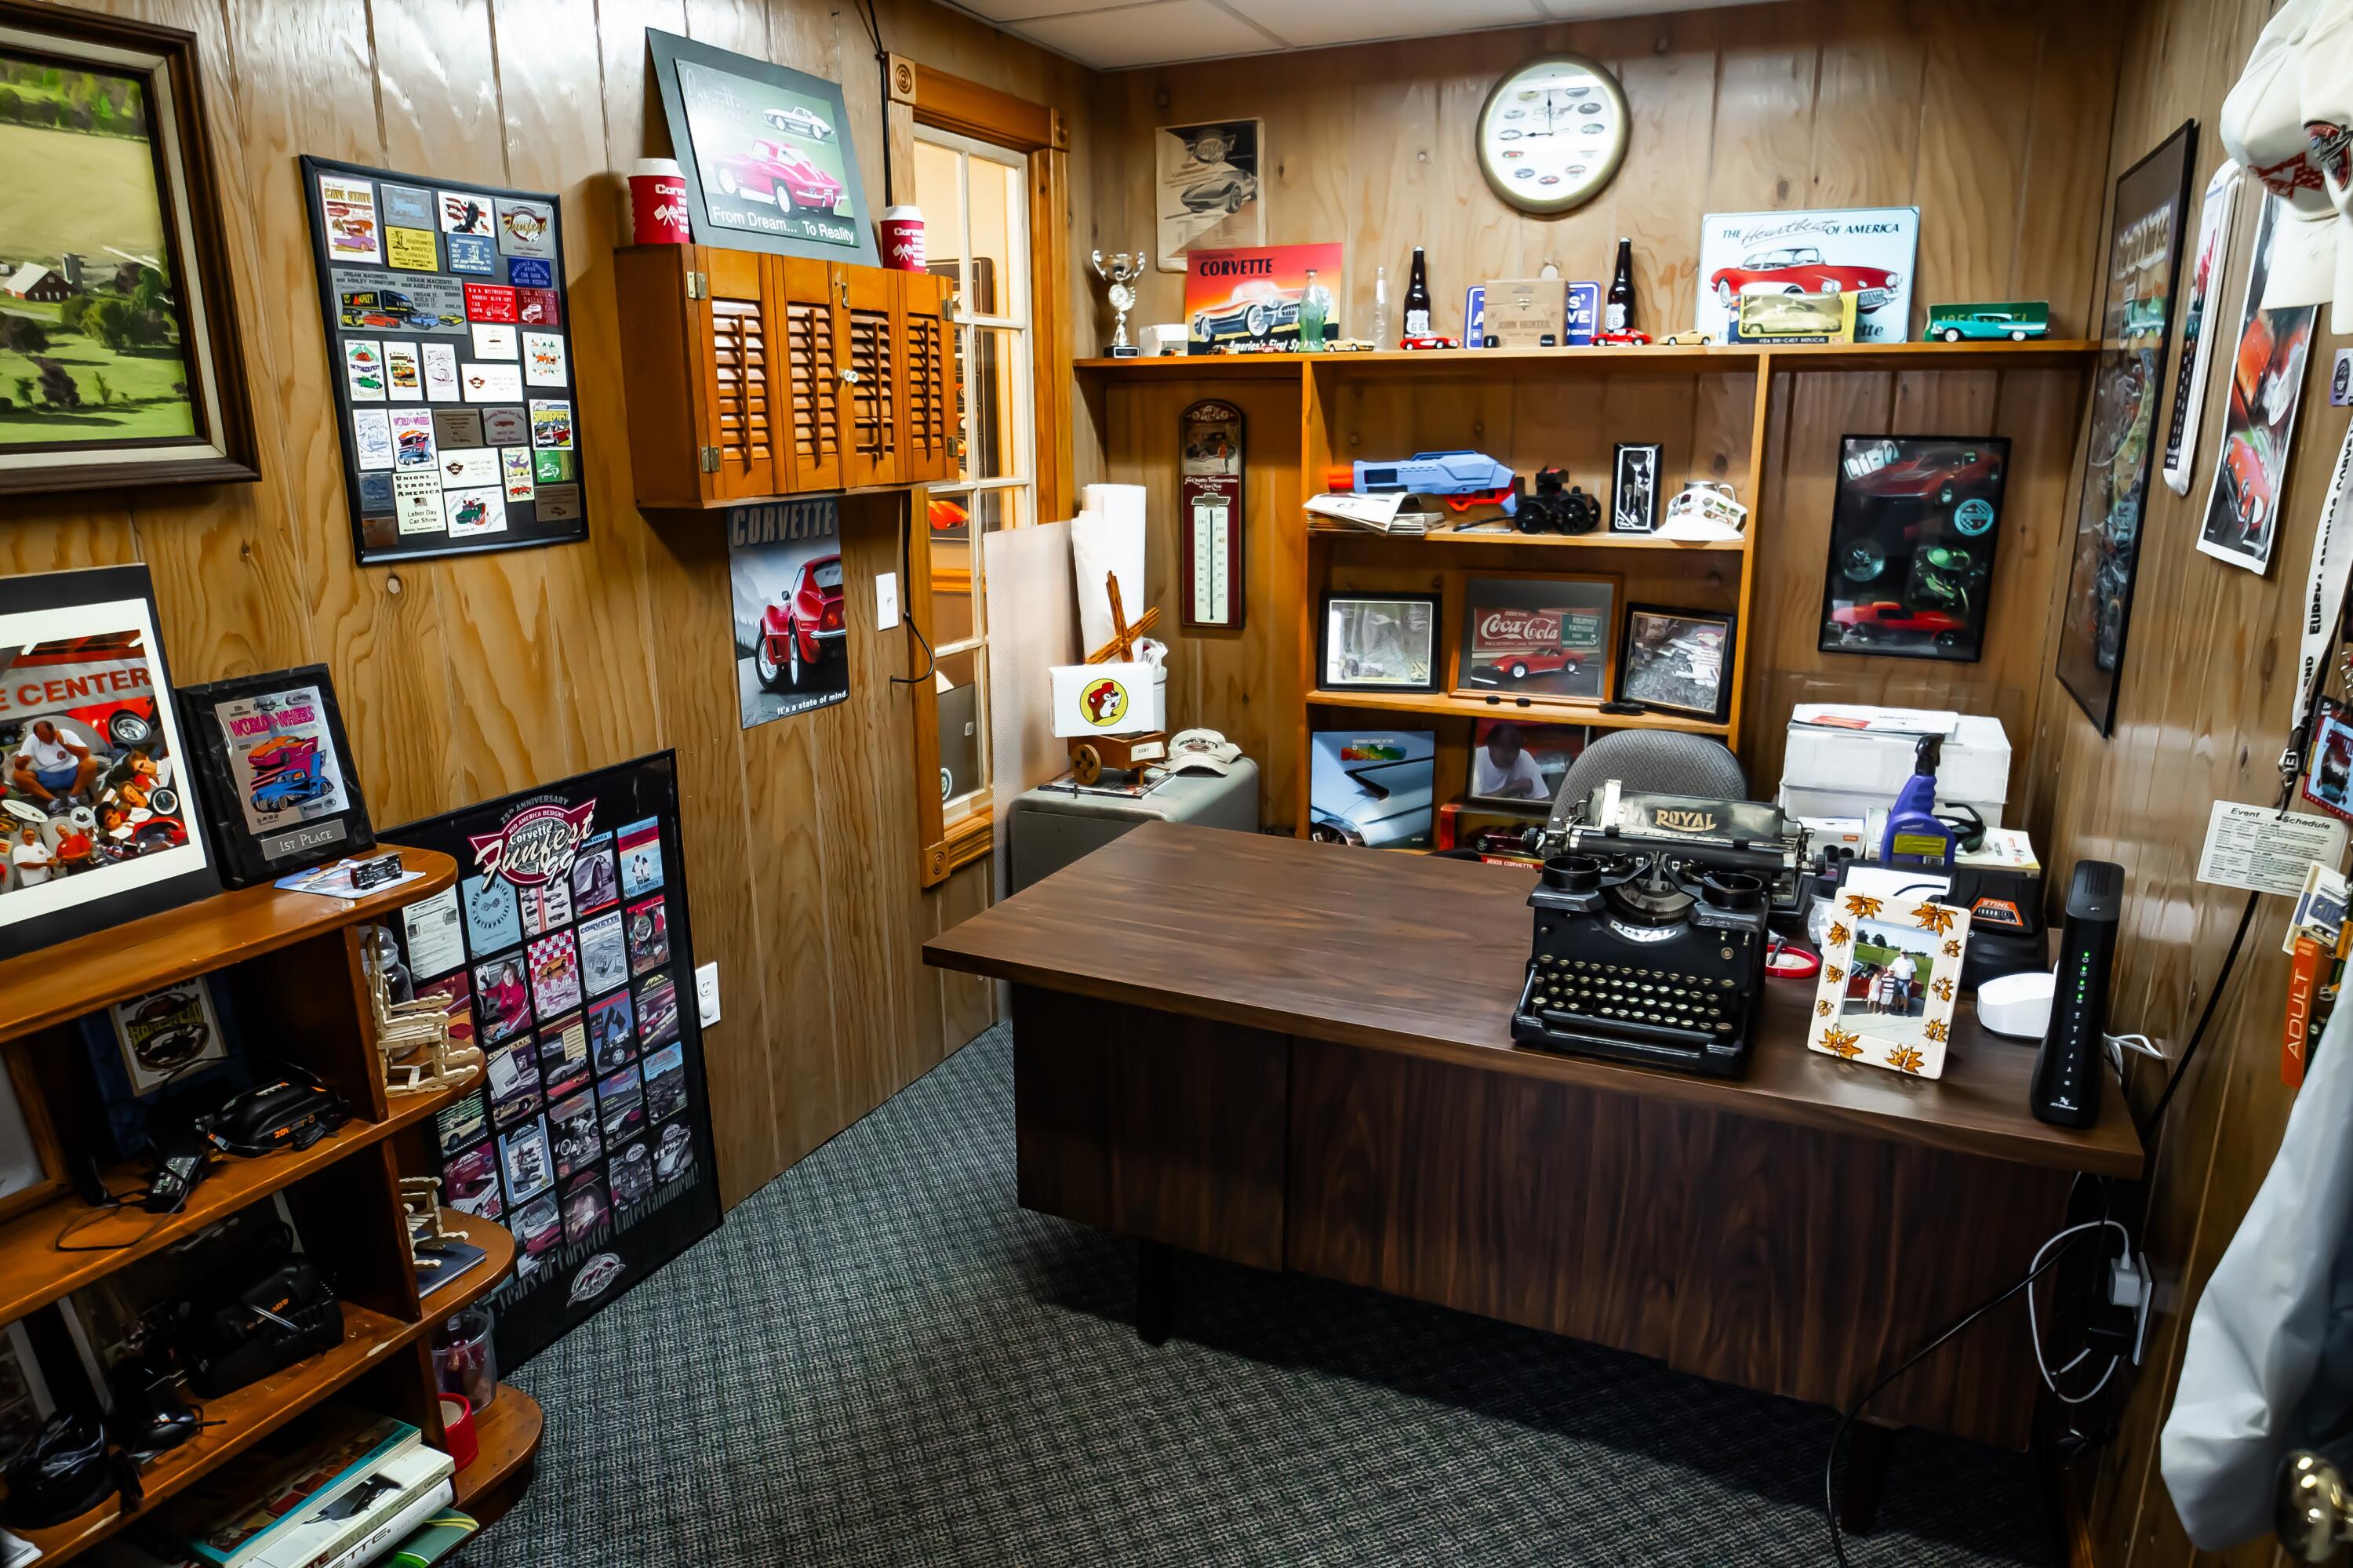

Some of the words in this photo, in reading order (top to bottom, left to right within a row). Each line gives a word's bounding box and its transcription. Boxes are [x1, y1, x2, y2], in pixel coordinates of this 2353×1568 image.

[712, 206, 744, 224] From
[747, 213, 797, 233] Dream...
[802, 220, 816, 236] To
[819, 224, 853, 244] Reality
[1722, 230, 1741, 238] THE
[1741, 218, 1838, 246] Heartbeat
[1826, 225, 1841, 235] OF
[1845, 224, 1899, 235] AMERICA
[1200, 258, 1275, 277] CORVETTE
[733, 502, 833, 547] CORVETTE
[1481, 613, 1558, 640] Coca-Cola
[17, 668, 151, 706] CENTER
[777, 706, 790, 715] It's
[798, 699, 817, 710] state
[819, 695, 827, 704] of
[229, 715, 269, 738] WORLD
[276, 705, 315, 728] WHEELS
[516, 795, 569, 813] ANNIVERSARY
[518, 811, 541, 826] AMERICA
[542, 810, 564, 819] DESIGNS
[1656, 809, 1718, 832] ROYAL
[2231, 807, 2261, 818] Event
[2282, 816, 2331, 830] Schedule
[279, 839, 296, 852] 1ST
[298, 831, 333, 848] PLACE
[510, 824, 552, 845] Corvette
[475, 810, 595, 890] Funfest
[1982, 900, 2009, 909] STIHL
[580, 915, 620, 934] CORVETTE
[1609, 919, 1677, 942] ROYAL
[2286, 966, 2310, 1060] ADULT
[275, 1127, 289, 1139] 20V
